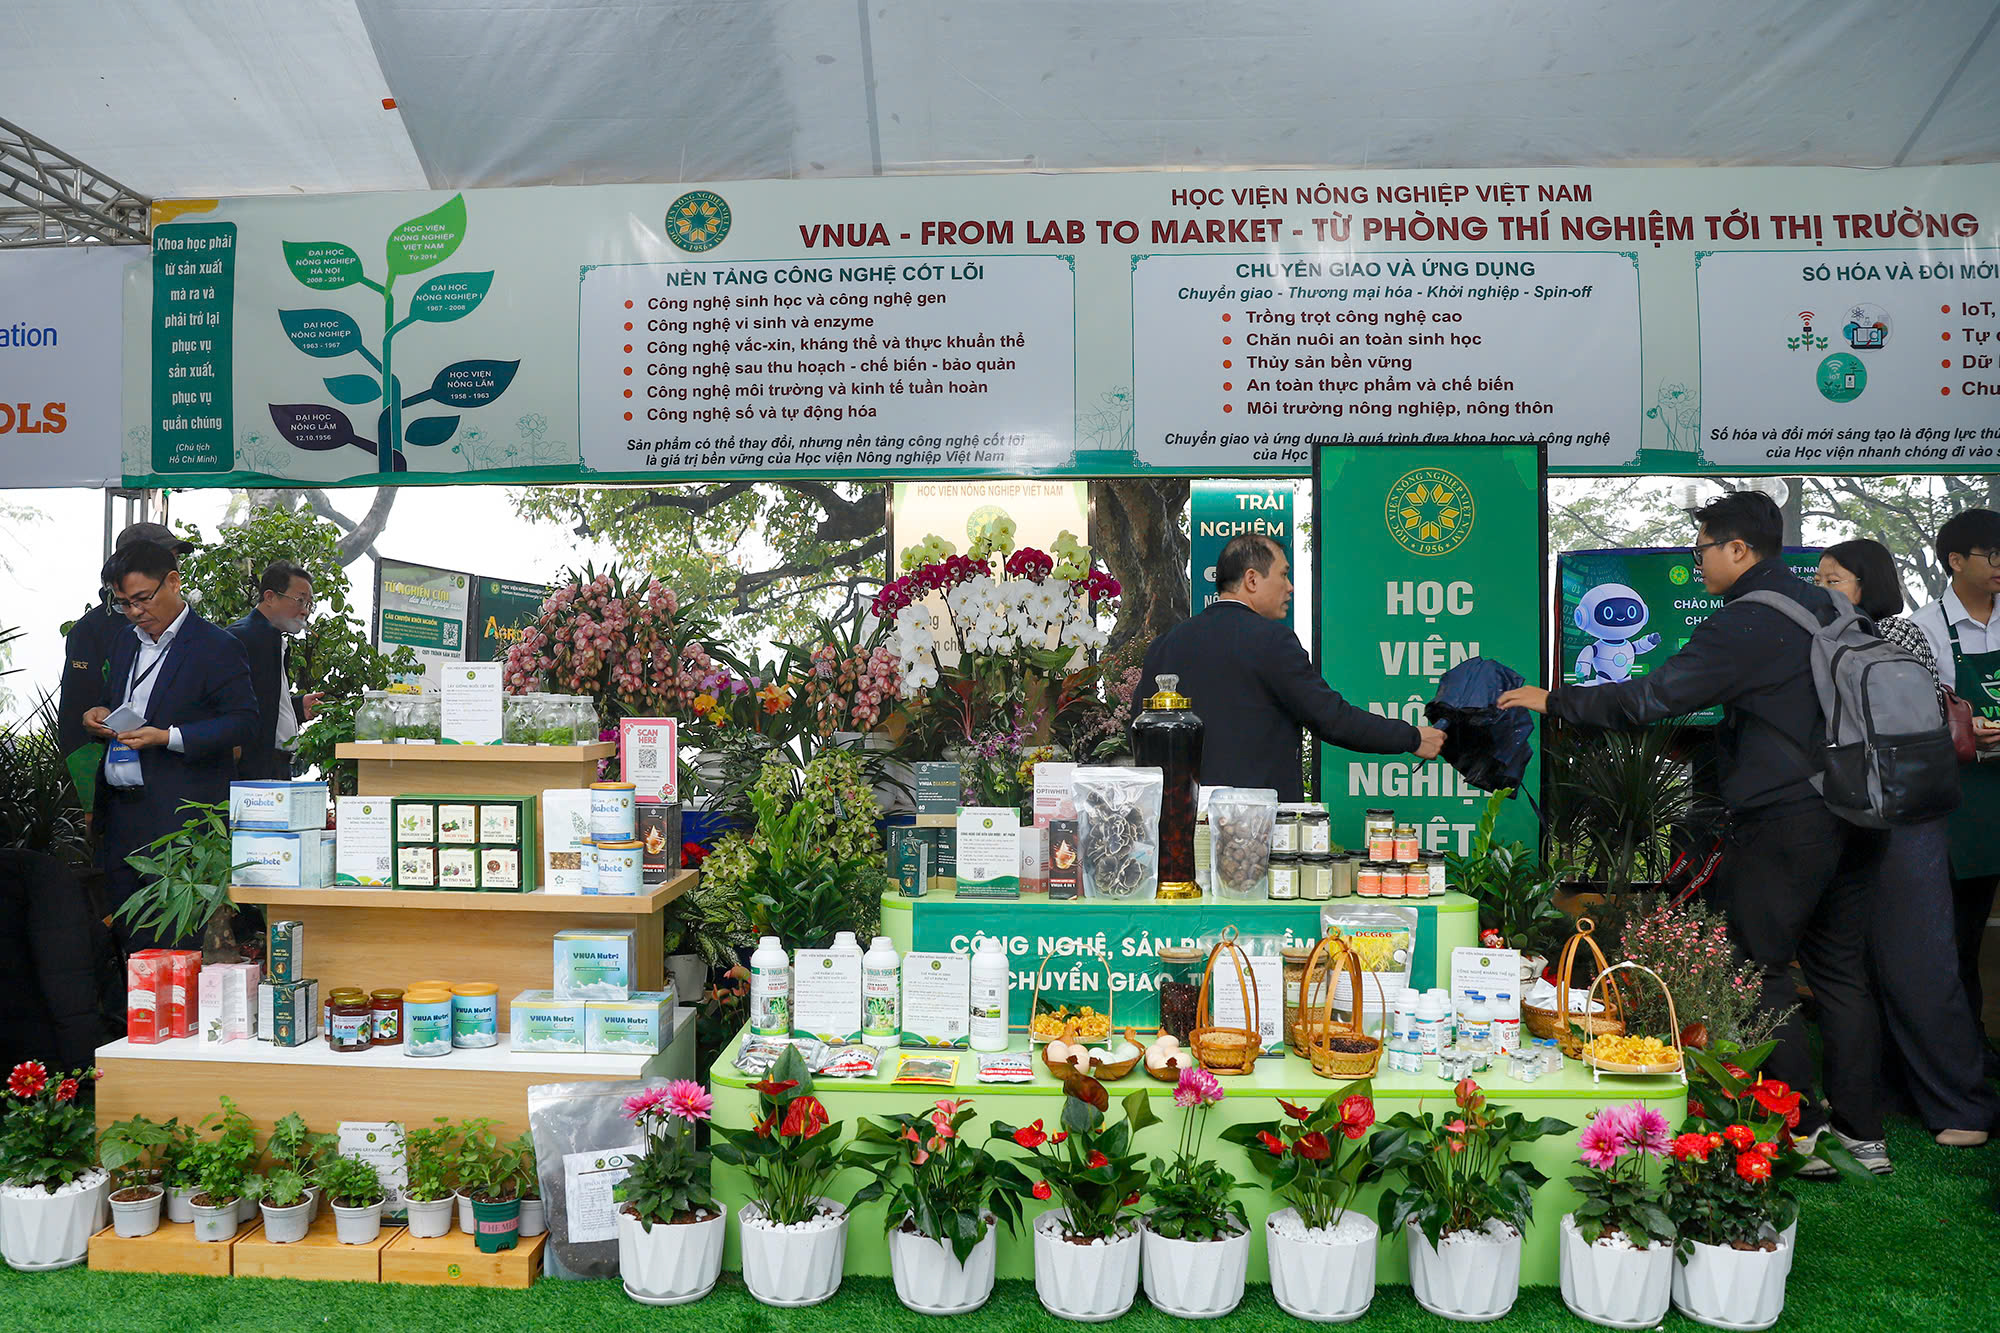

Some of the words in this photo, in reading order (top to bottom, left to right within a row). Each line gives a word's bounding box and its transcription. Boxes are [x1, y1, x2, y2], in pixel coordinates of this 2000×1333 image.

[1172, 189, 1224, 209] HỌC
[1232, 185, 1287, 208] VIỆN
[1296, 184, 1368, 204] NÔNG
[1377, 183, 1469, 206] NGHIỆP
[1476, 182, 1530, 206] VIỆT
[1538, 185, 1592, 202] NAM
[425, 224, 445, 232] VIỆN
[799, 223, 890, 248] VNUA
[922, 220, 1013, 245] FROM
[1027, 220, 1085, 244] LAB
[1096, 220, 1139, 244] TO
[1152, 219, 1282, 244] MARKET
[1312, 211, 1352, 241] TỪ
[1363, 210, 1488, 241] PHÒNG
[1498, 209, 1550, 240] THÍ
[1561, 210, 1694, 248] NGHIỆM
[1704, 208, 1760, 240] TỚI
[1770, 215, 1822, 246] THỊ
[1833, 206, 1979, 238] TRƯỜNG
[157, 238, 184, 250] Khoa
[187, 237, 206, 252] học
[209, 234, 232, 250] phải
[166, 262, 176, 276] từ
[178, 261, 196, 275] sản
[199, 259, 222, 274] xuất
[667, 269, 706, 286] NỀN
[713, 268, 767, 285] TẢNG
[774, 266, 832, 284] CÔNG
[840, 265, 896, 284] NGHỆ
[903, 263, 944, 280] CỐT
[952, 263, 983, 280] LÕI
[1236, 260, 1321, 278] CHUYỂN
[1329, 261, 1381, 278] GIAO
[1388, 258, 1416, 277] VÀ
[1422, 258, 1468, 276] ỨNG
[1476, 262, 1534, 278] DỤNG
[1803, 263, 1830, 281] SỐ
[1837, 262, 1880, 280] HÓA
[1885, 262, 1914, 280] VÀ
[1918, 262, 1954, 279] ĐỔI
[1960, 260, 1999, 279] MỚI
[171, 288, 186, 300] mà
[190, 290, 200, 300] ra
[203, 286, 214, 299] và
[648, 298, 687, 312] Công
[694, 296, 730, 311] nghệ
[736, 295, 768, 307] sinh
[774, 295, 802, 309] học
[807, 294, 824, 306] và
[830, 293, 868, 308] công
[874, 292, 912, 307] nghệ
[917, 294, 946, 306] gen
[1962, 302, 1995, 318] IoT,
[165, 312, 186, 328] phải
[190, 311, 204, 325] trở
[207, 312, 219, 327] lại
[1246, 308, 1295, 326] Trồng
[1300, 312, 1330, 326] trọt
[1336, 310, 1378, 325] công
[1385, 310, 1426, 326] nghệ
[1432, 313, 1462, 322] cao
[1962, 328, 1990, 345] Tự
[172, 339, 196, 354] phục
[200, 340, 211, 353] vụ
[1963, 355, 1992, 368] Dữ
[169, 364, 186, 378] sản
[190, 362, 214, 377] xuất,
[172, 391, 196, 406] phục
[200, 392, 211, 405] vụ
[163, 415, 188, 431] quần
[191, 416, 222, 430] chúng
[291, 422, 315, 430] NÔNG
[318, 422, 336, 430] LÂM
[296, 414, 310, 422] ĐẠI
[176, 443, 194, 452] (Chủ
[196, 443, 210, 452] tịch
[169, 454, 180, 463] Hồ
[196, 456, 217, 464] Minh)
[1236, 491, 1284, 510] TRẢI
[1201, 518, 1283, 536] NGHIỆM
[1419, 544, 1444, 554] 1956
[1386, 581, 1474, 623] HỌC
[1674, 596, 1708, 609] CHÀO
[637, 729, 658, 737] SCAN
[243, 798, 275, 808] Diabete
[597, 952, 619, 960] Nutri
[474, 1006, 492, 1014] Nutri
